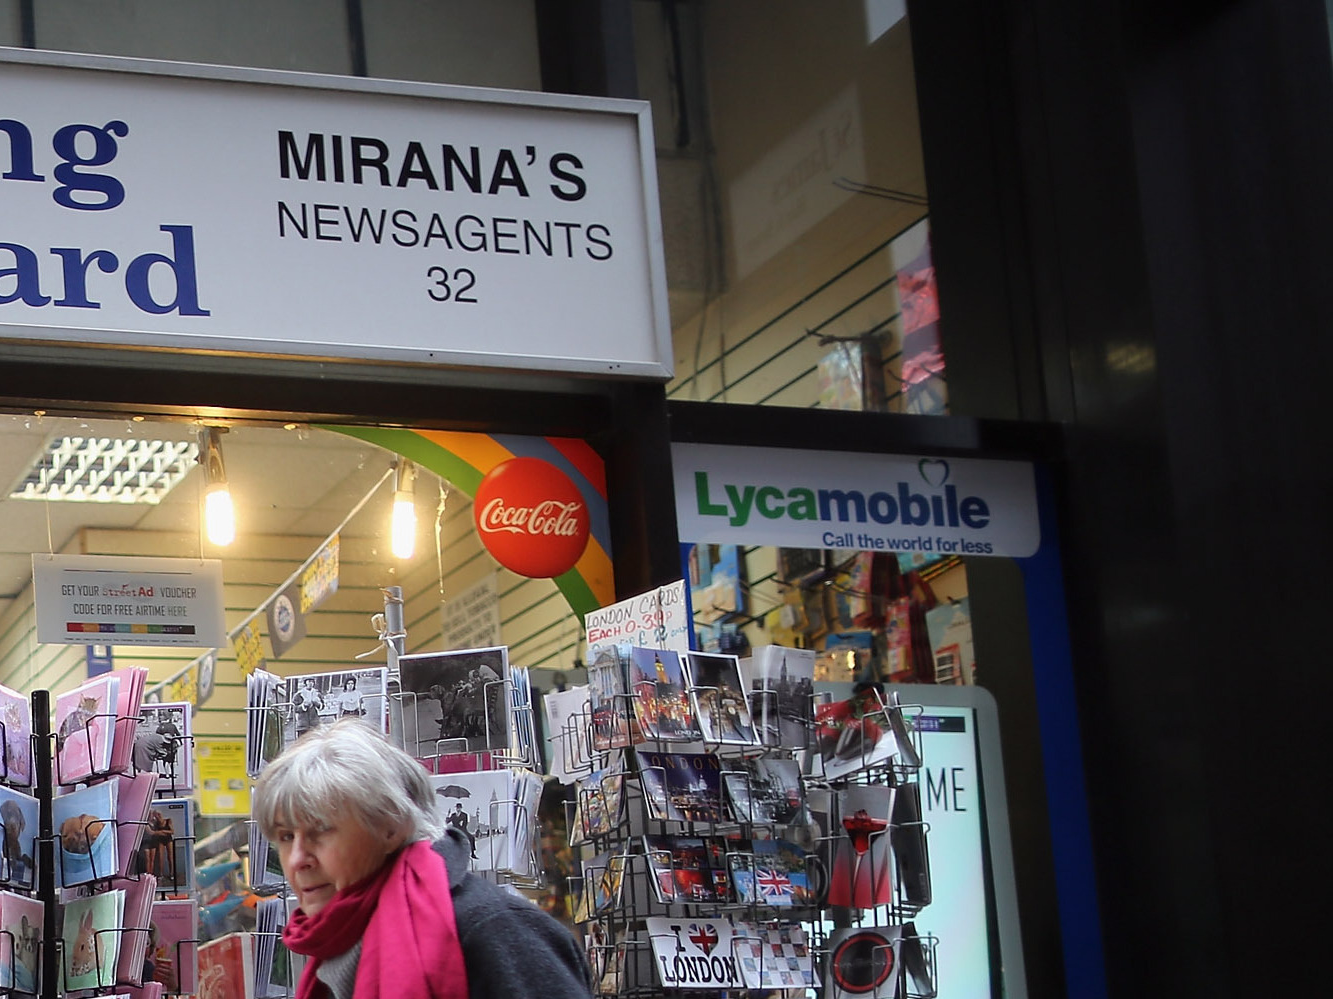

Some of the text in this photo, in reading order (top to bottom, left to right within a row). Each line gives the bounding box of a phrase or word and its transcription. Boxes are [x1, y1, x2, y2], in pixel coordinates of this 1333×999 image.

[277, 129, 587, 201] MIRANA'S
[277, 200, 613, 261] NEWSAGENTS
[426, 265, 478, 303] 32
[693, 470, 990, 529] Lycamobile
[479, 497, 582, 536] Coca-Cola
[822, 531, 993, 554] Call the world for less
[61, 584, 196, 598] GET YOUR VOUCHER
[73, 603, 187, 617] CODE FOR FREE AIRTIME HERE
[586, 600, 634, 629] LONDON
[587, 625, 621, 643] EACH
[670, 925, 686, 952] I
[659, 955, 739, 983] LONDON
